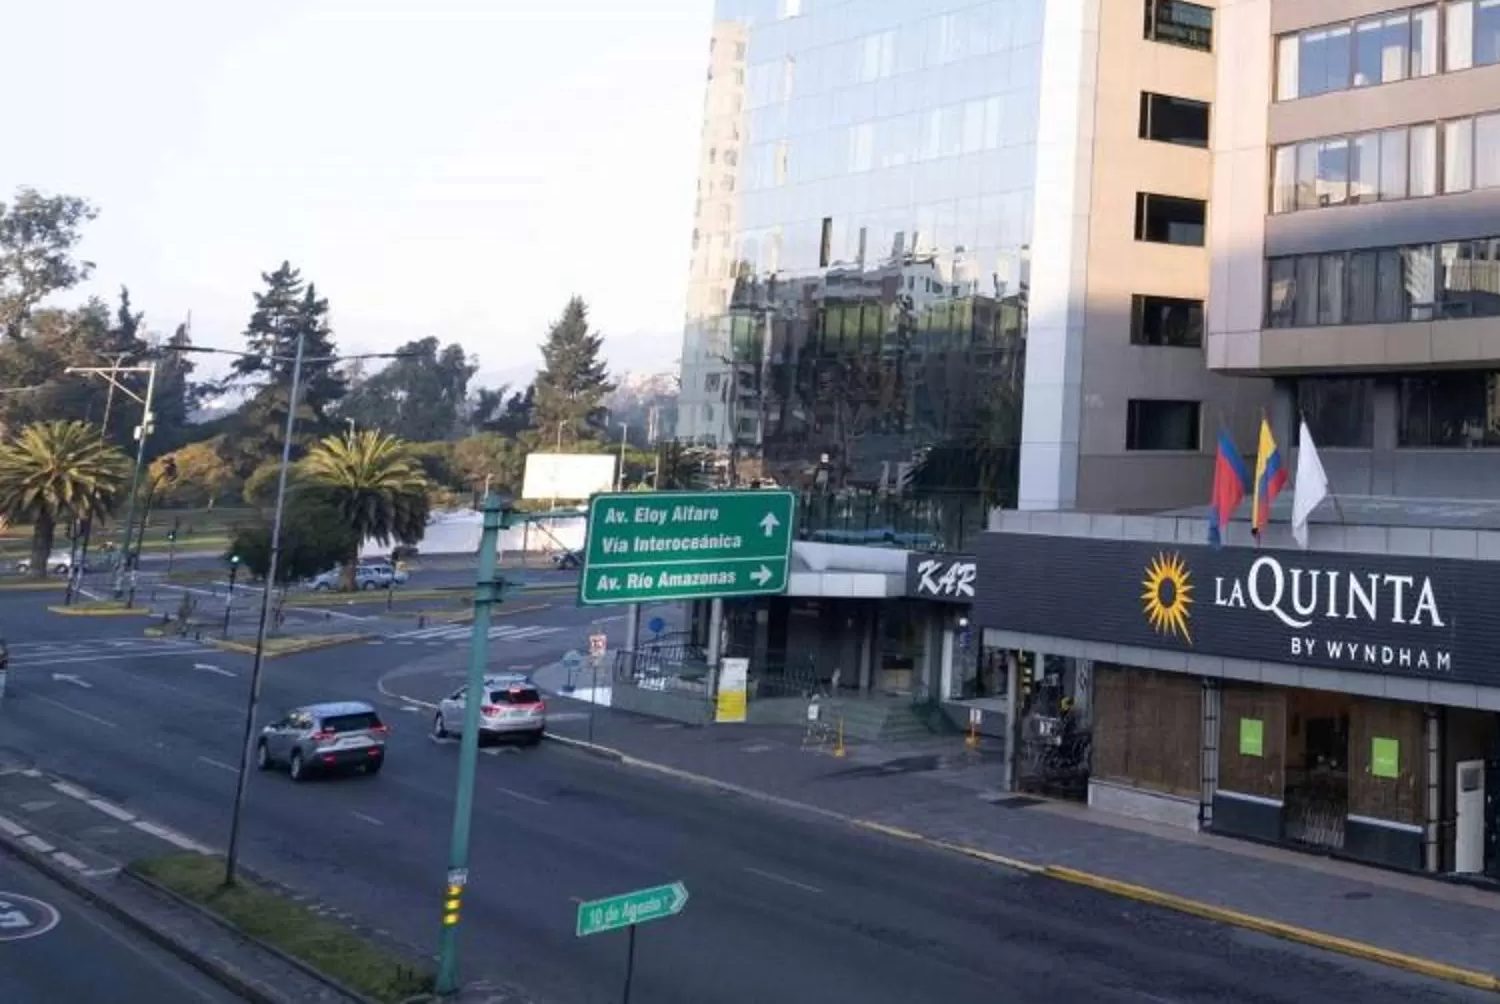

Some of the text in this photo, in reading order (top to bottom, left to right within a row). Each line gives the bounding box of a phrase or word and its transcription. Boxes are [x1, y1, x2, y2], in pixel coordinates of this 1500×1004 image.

[604, 505, 719, 525] Av. Eloy Alfaro
[633, 533, 742, 552] Interoceánica
[597, 574, 621, 591] Av.
[657, 571, 736, 588] Amazonas
[1248, 555, 1445, 628] QUINTA
[1291, 637, 1450, 670] BY WYNDHAM
